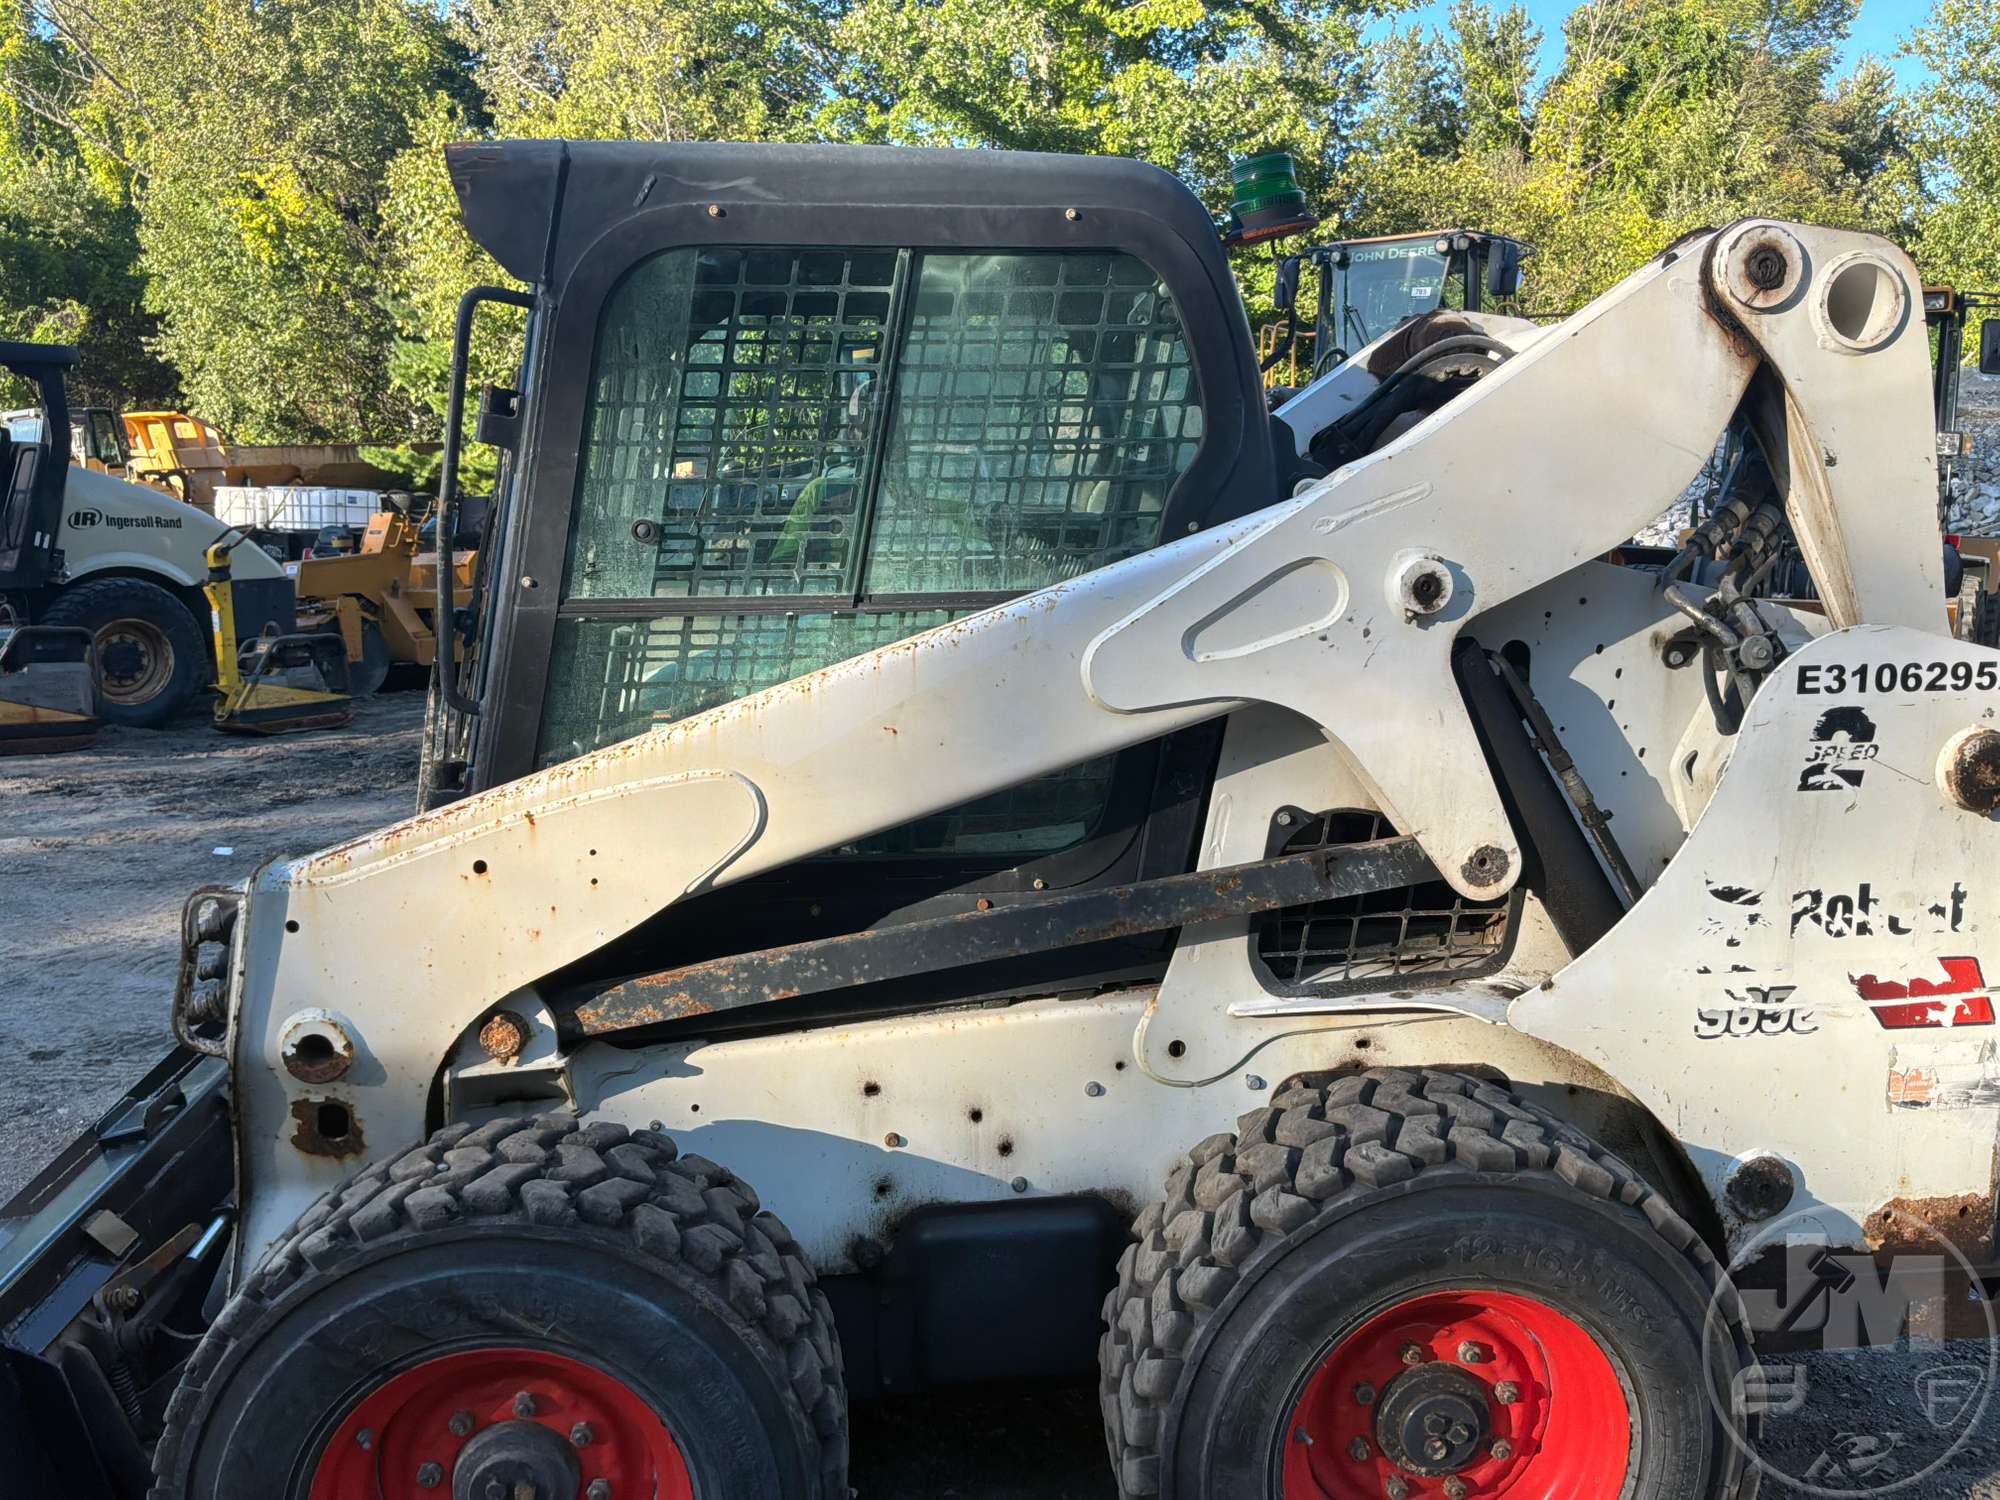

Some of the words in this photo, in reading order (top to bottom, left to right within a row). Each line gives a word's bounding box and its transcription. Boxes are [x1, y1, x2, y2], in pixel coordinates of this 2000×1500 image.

[1350, 250, 1386, 263] JOHN
[1387, 246, 1437, 260] DEERE
[105, 515, 154, 530] Ingersoll
[1797, 661, 2000, 695] E3106295
